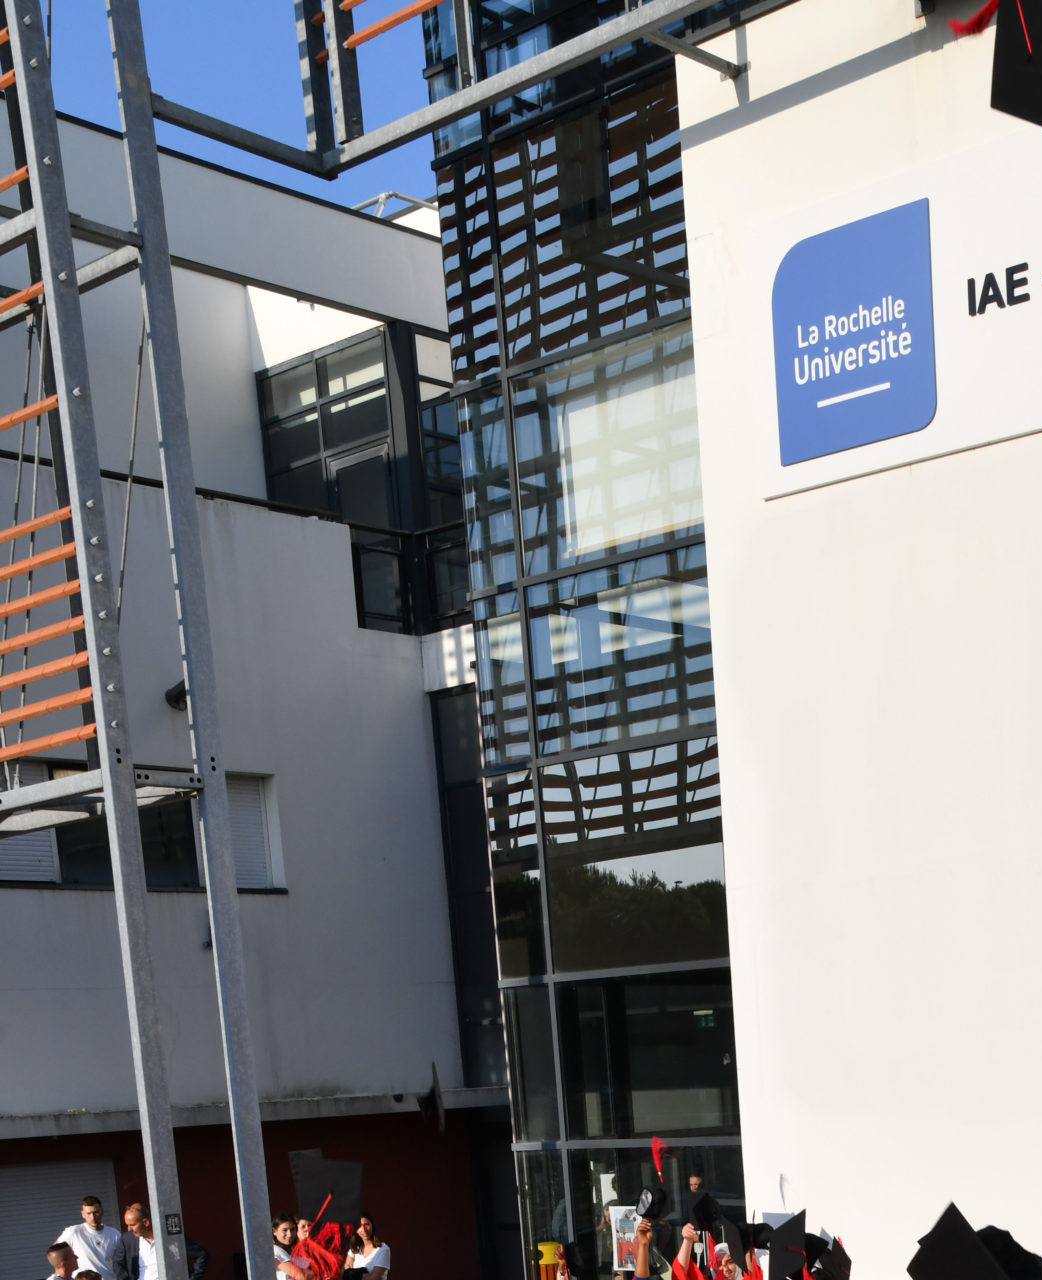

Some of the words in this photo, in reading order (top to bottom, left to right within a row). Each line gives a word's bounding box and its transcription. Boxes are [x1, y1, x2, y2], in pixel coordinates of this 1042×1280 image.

[967, 262, 1031, 317] IAE
[797, 324, 819, 349] La
[824, 295, 905, 340] Rochelle
[794, 322, 912, 386] Université
